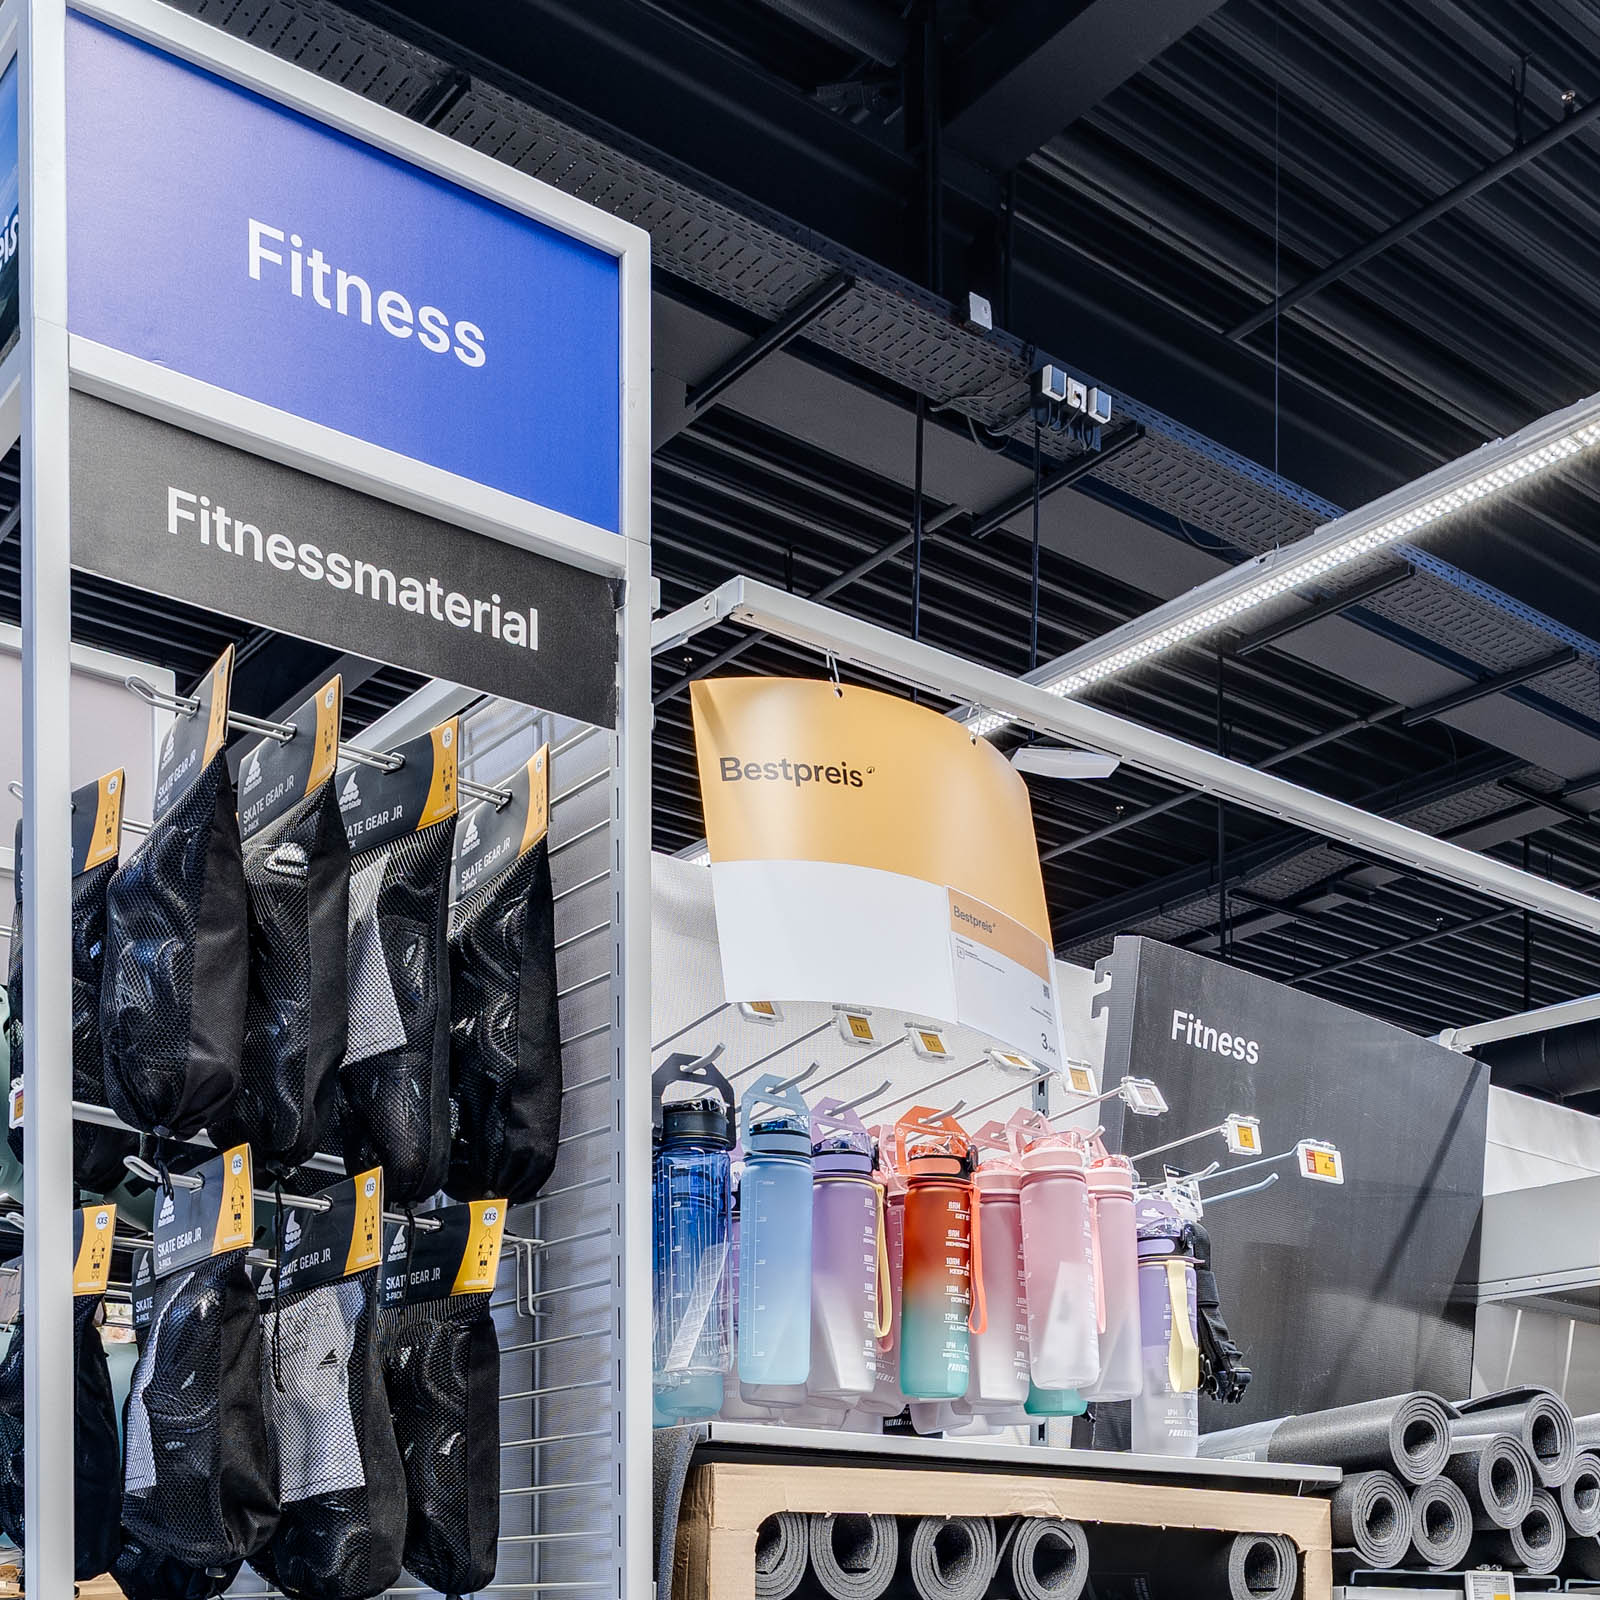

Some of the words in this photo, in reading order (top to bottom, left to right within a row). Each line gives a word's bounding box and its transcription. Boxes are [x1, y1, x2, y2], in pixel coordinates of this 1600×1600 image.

[247, 217, 487, 368] Fitness
[167, 485, 540, 652] Fitnessmaterial
[157, 775, 174, 801] SKATE
[173, 761, 189, 786] GEAR
[189, 749, 197, 769] JR
[720, 757, 864, 788] Bestpreis
[242, 796, 265, 823] SKATE
[266, 784, 286, 811] GEAR
[285, 774, 296, 794] JR
[366, 813, 390, 831] GEAR
[390, 804, 403, 826] JR
[461, 858, 483, 884] SKATE
[483, 845, 502, 868] GEAR
[501, 836, 511, 854] JR
[953, 904, 993, 934] Bestpreis
[1171, 1009, 1260, 1065] Fitness
[232, 1158, 242, 1170] XXS
[365, 1182, 375, 1193] XXS
[96, 1216, 109, 1226] XXS
[483, 1212, 498, 1222] XXS
[157, 1240, 177, 1258] SKATE
[176, 1234, 194, 1251] GEAR
[193, 1227, 202, 1242] JR
[300, 1254, 320, 1271] GEAR
[322, 1247, 332, 1263] JR
[410, 1271, 430, 1285] GEAR
[430, 1267, 441, 1281] JR
[135, 1296, 153, 1312] SKATE
